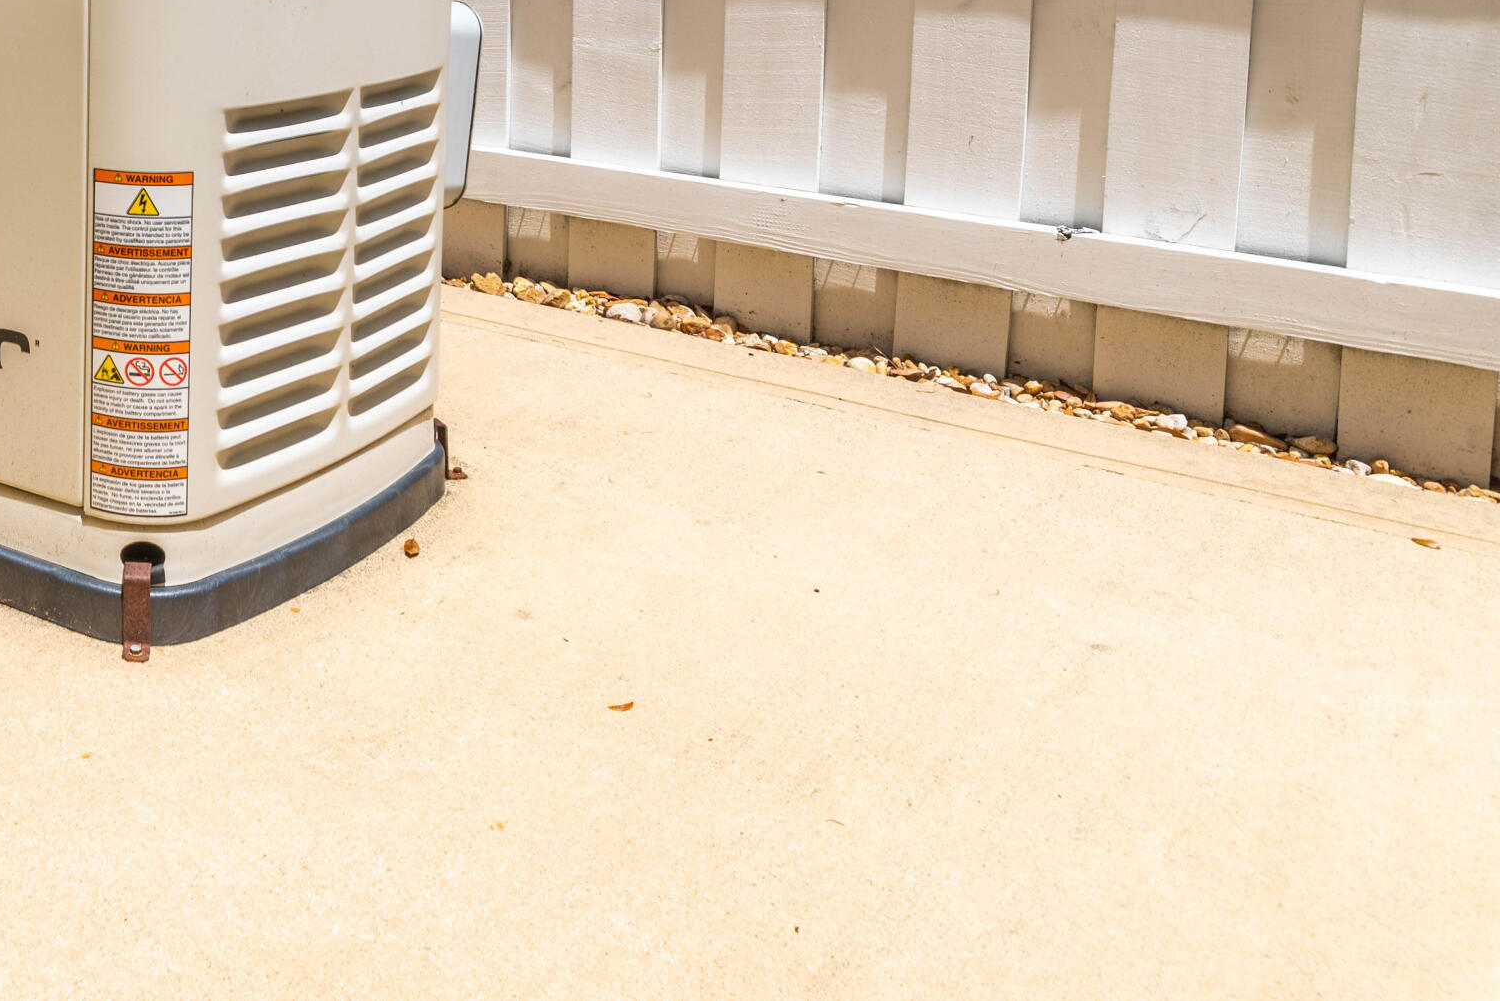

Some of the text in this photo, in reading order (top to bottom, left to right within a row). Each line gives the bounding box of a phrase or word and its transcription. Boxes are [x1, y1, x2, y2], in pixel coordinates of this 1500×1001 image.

[126, 174, 174, 184] WARNING
[108, 246, 188, 257] AVERTISSEMENT
[112, 294, 182, 304] ADVERTENCIA
[123, 343, 171, 352] WARNING
[106, 418, 186, 430] AVERTISSEMENT
[110, 467, 179, 478] ADVERTENCIA
